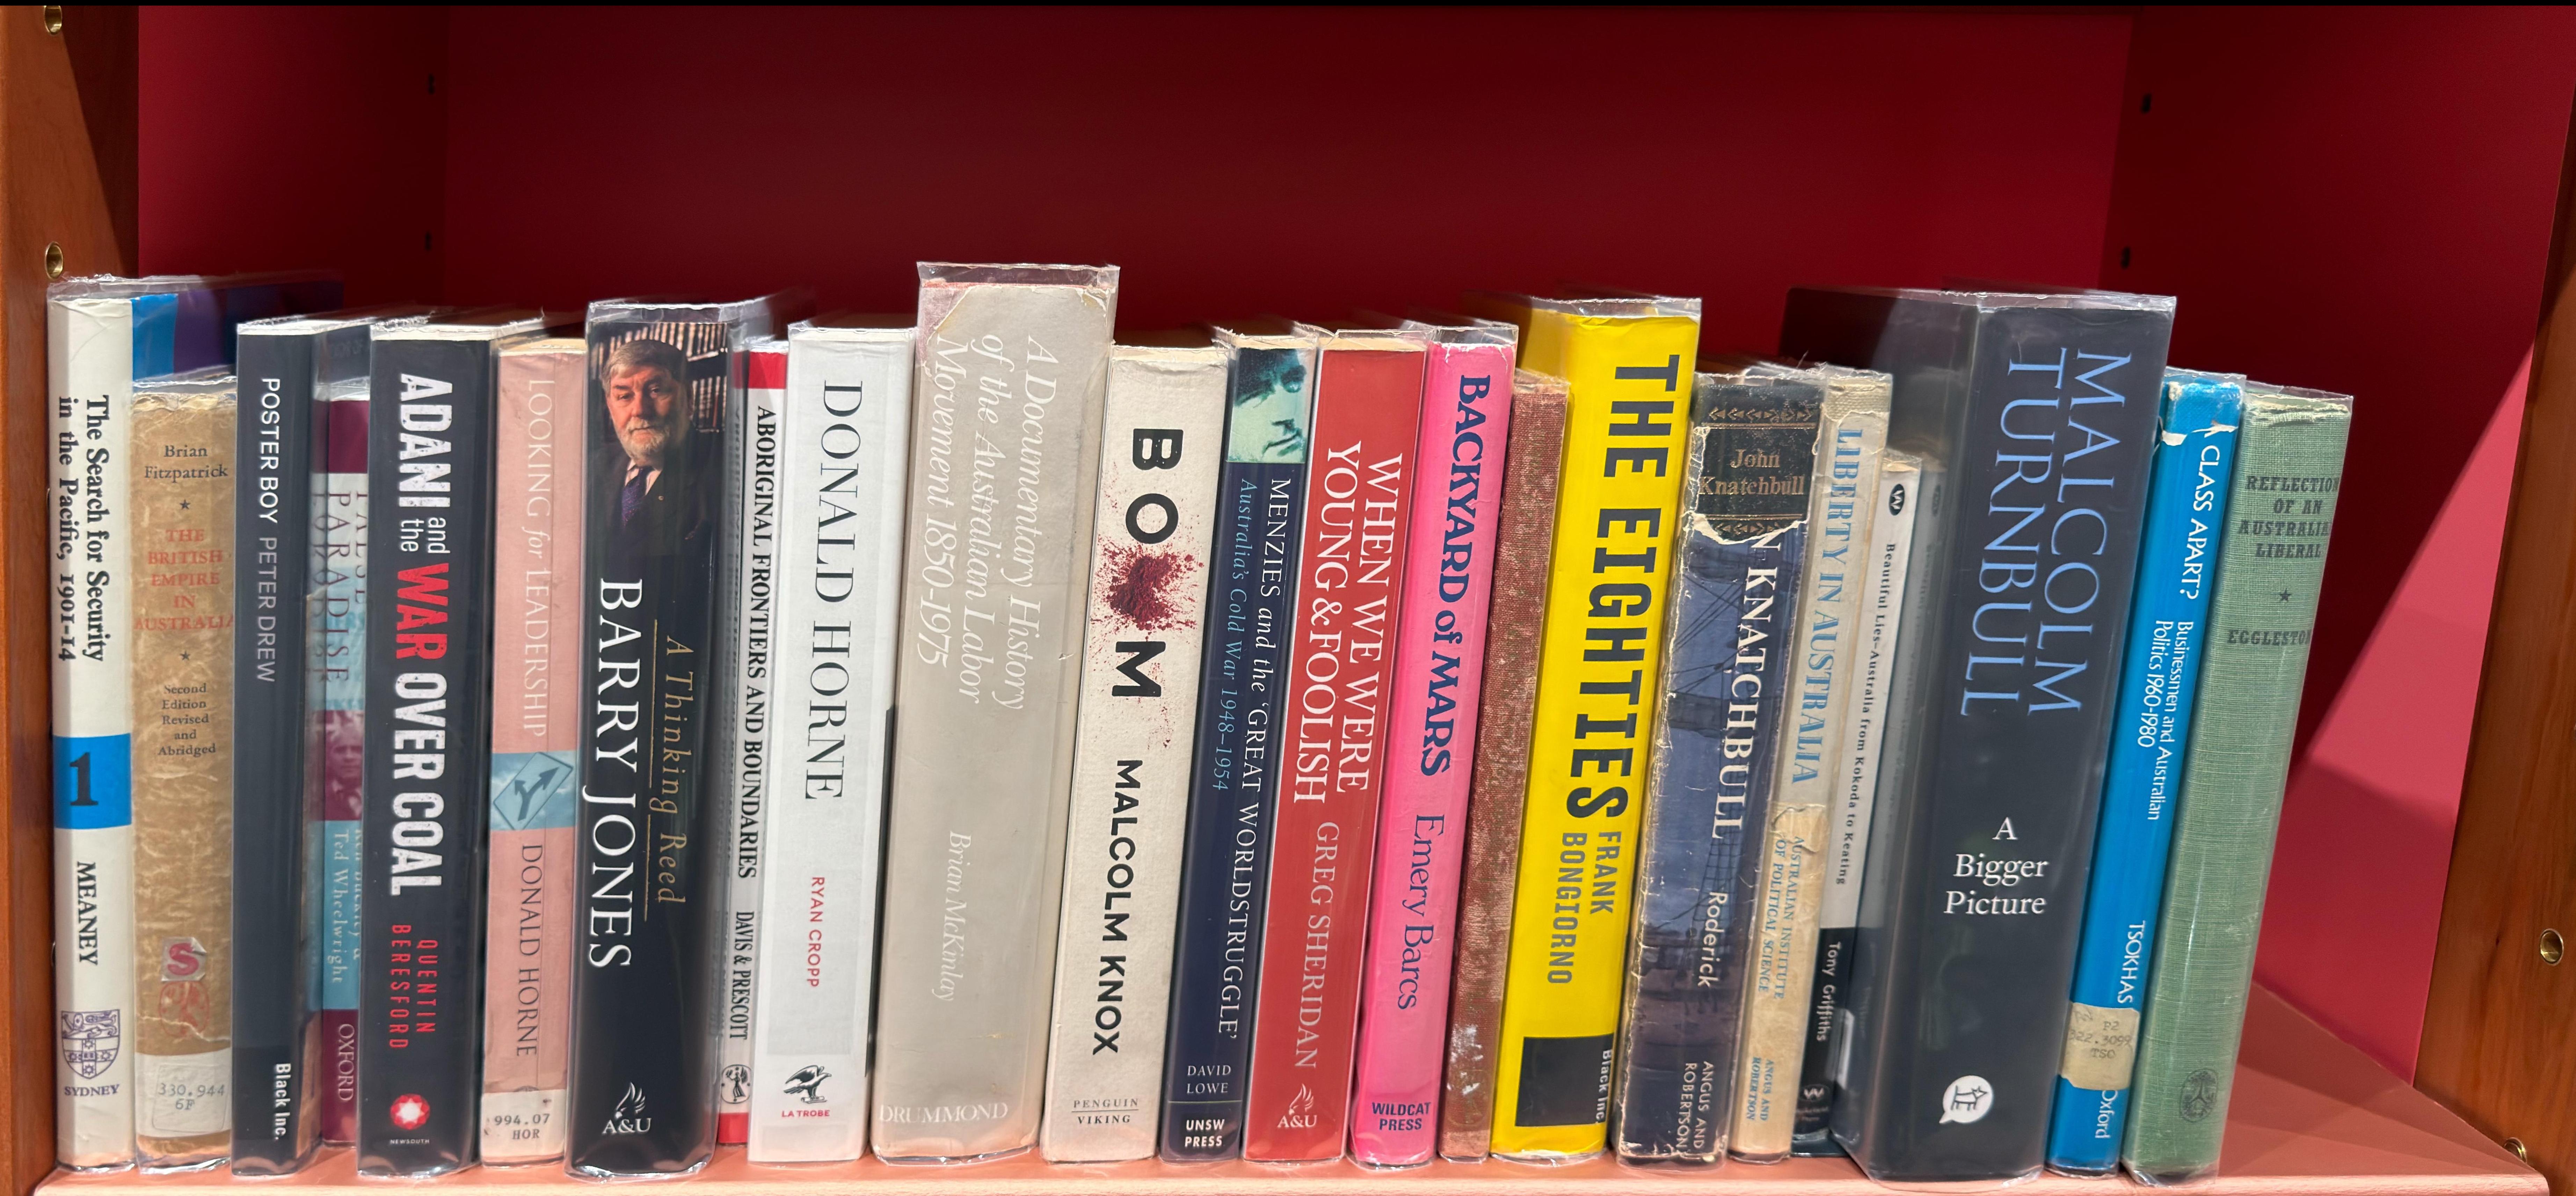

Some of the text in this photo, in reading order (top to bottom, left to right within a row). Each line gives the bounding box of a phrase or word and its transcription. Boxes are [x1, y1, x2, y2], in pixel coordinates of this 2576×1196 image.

[164, 445, 208, 457] Brian
[399, 373, 452, 507] ADANI
[927, 333, 968, 508] Movement
[1730, 449, 1780, 468] John
[57, 397, 79, 560] in the Pacific,
[144, 465, 228, 482] Fitzpatrick
[1699, 476, 1804, 495] Knatchbull
[2193, 445, 2220, 511] CLASS
[2273, 498, 2323, 514] OF AN
[83, 395, 110, 662] The Search for Security
[148, 551, 223, 565] BRITISH
[166, 529, 204, 542] THE
[257, 378, 279, 682] POSTER BOY PETER DREW
[400, 518, 424, 552] the
[428, 517, 450, 554] and
[522, 380, 555, 736] LOOKING for LEADERSHIP
[959, 334, 1015, 704] of the Australian Labor
[991, 335, 1058, 710] A Documentary History
[1960, 347, 2067, 716] TURNBULL
[2028, 349, 2132, 716] MALCOLM
[2180, 518, 2208, 600] APART?
[2255, 543, 2322, 558] LIBERAL
[152, 573, 220, 586] EMPIRE
[174, 596, 195, 608] IN
[326, 494, 350, 682] PARADISE
[805, 380, 862, 799] DONALD HORNE
[1251, 479, 1291, 692] MENZIES and the
[1420, 375, 1491, 777] BACKYARD of MARS
[1566, 354, 1680, 818] THE EIGHTIES
[1792, 428, 1864, 784] LIBERTY IN AUSTRALIA
[738, 406, 777, 879] ABORIGINAL FRONTIERS AND BOUNDARIES
[1223, 589, 1247, 678] Cold War
[1293, 440, 1362, 804] YOUNG & FOOLISH
[1336, 453, 1403, 793] WHEN WE WERE
[162, 699, 206, 710] Edition
[162, 714, 209, 725] Revised
[164, 684, 206, 694] Second
[1712, 566, 1777, 839] KNATCHBULL
[1836, 543, 1895, 884] Beautiful from Kokoda to Keating
[2138, 620, 2174, 748] Politics 1960-1980
[2148, 621, 2194, 821] Businessmen and Australian
[158, 743, 216, 756] Abridged
[175, 729, 197, 740] and
[391, 563, 449, 895] WAR OVER COAL
[649, 635, 694, 903] A Thinking Reed
[69, 752, 98, 806] 1
[583, 578, 642, 967] BARRY JONES
[1993, 817, 2017, 840] A
[327, 829, 349, 983] Ted Wheelwright
[1092, 760, 1143, 1055] MALCOLM KNOX
[1547, 831, 1587, 984] BONGIORNO
[1590, 831, 1622, 915] FRANK
[1943, 890, 2046, 915] Picture
[1953, 854, 2049, 887] Bigger
[77, 862, 97, 965] MEANEY
[516, 845, 542, 1056] DONALD HORNE
[807, 876, 825, 988] RYAN CROPP
[932, 830, 972, 1001] Brian McKinlay
[1295, 822, 1339, 1069] GREG SHERIDAN
[1397, 814, 1445, 1011] Emery Barcs
[1697, 891, 1728, 988] Roderick
[1759, 839, 1787, 992] OF POLITICAL SCIENCE
[389, 924, 412, 1048] BERESFORD
[416, 940, 438, 1033] QUENTIN
[729, 911, 754, 1040] DAVIS & PRESCOTT
[1774, 927, 1792, 999] INSTITUTE
[1817, 942, 1841, 1042] Tony Griffiths
[2117, 920, 2145, 1004] TSOKHAS
[65, 1084, 120, 1096] SYDNEY
[158, 1083, 225, 1097] 330.944
[275, 1063, 291, 1106] Black
[339, 1024, 355, 1101] OXFORD
[1073, 1098, 1138, 1108] PENGUIN
[1187, 1065, 1231, 1076] DAVID
[1187, 1083, 1228, 1094] LOWE
[1599, 1049, 1613, 1092] Black
[1747, 1057, 1761, 1120] ROBERTSON
[1760, 1059, 1774, 1121] ANGUS AND
[494, 1114, 550, 1125] 994.07
[512, 1129, 540, 1140] HOR
[602, 1118, 652, 1135] A&U
[879, 1102, 1008, 1124] DRUMMOND
[1077, 1114, 1130, 1124] VIKING
[1185, 1136, 1222, 1147] PRESS
[1186, 1119, 1225, 1130] UNSW
[1277, 1115, 1317, 1128] A&U
[1371, 1102, 1431, 1116] WILDCAT
[1379, 1118, 1422, 1131] PRESS
[1694, 1061, 1714, 1149] ANGUS AND
[2095, 1090, 2118, 1139] Oxford
